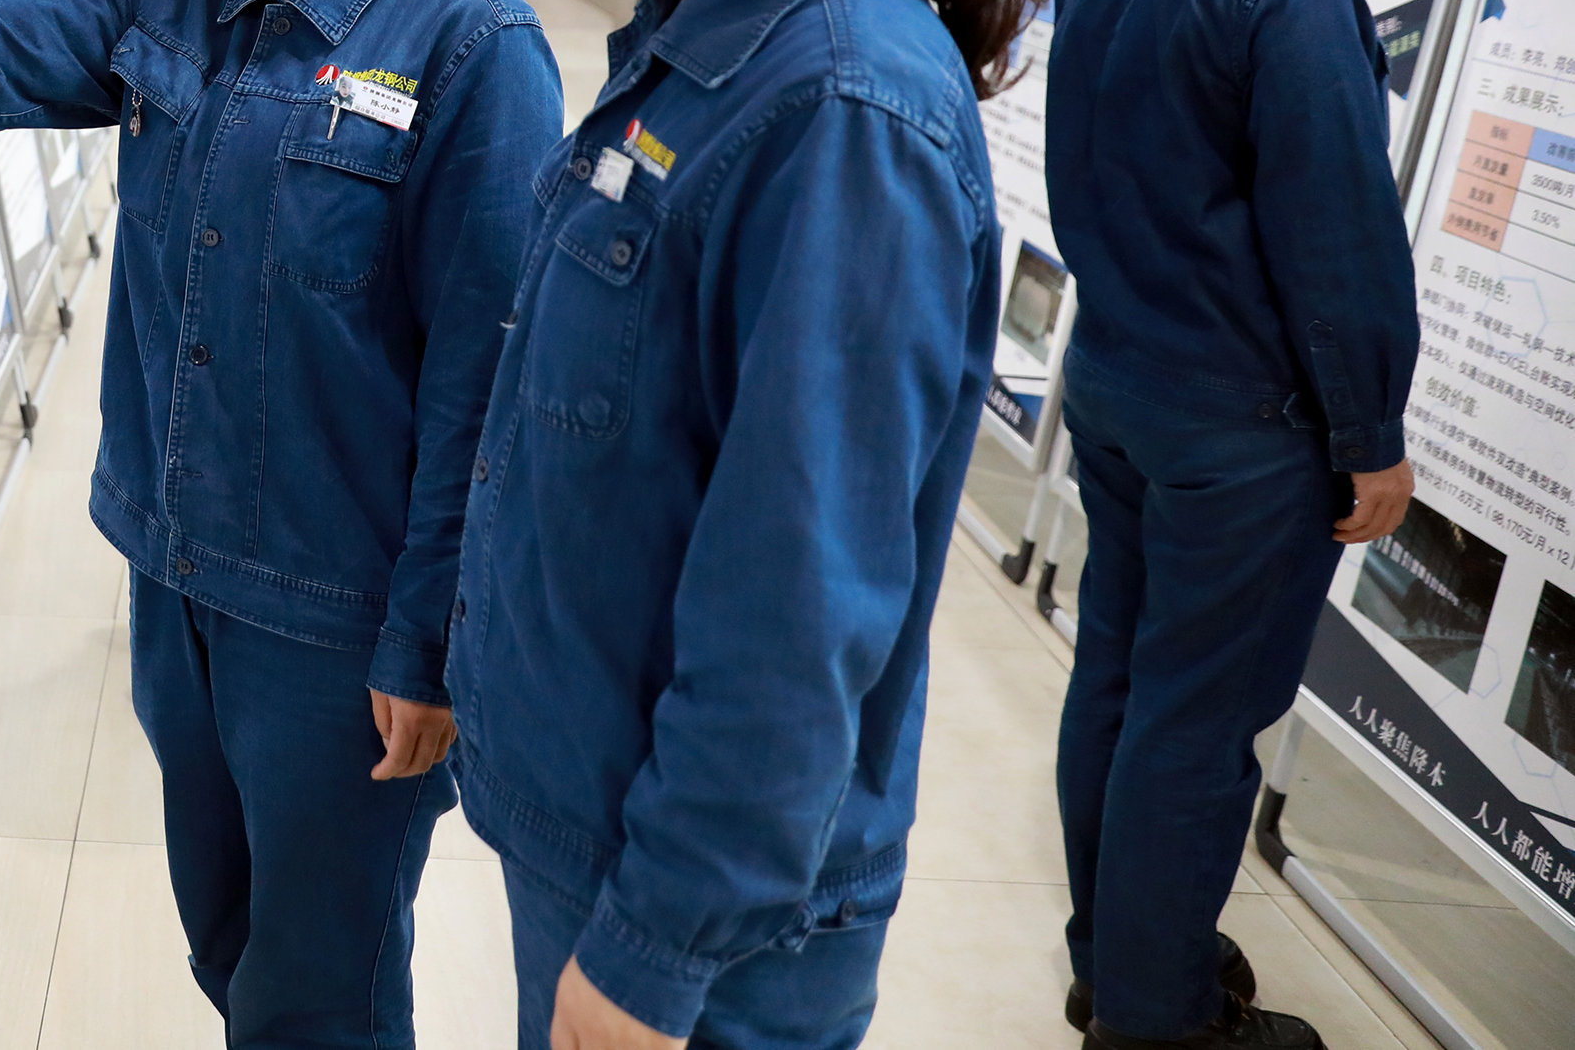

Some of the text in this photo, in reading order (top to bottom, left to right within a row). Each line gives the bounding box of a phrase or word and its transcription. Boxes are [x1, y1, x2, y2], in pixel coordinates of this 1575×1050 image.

[342, 68, 419, 94] 龙钢公司
[1346, 694, 1447, 788] 人人聚焦降本
